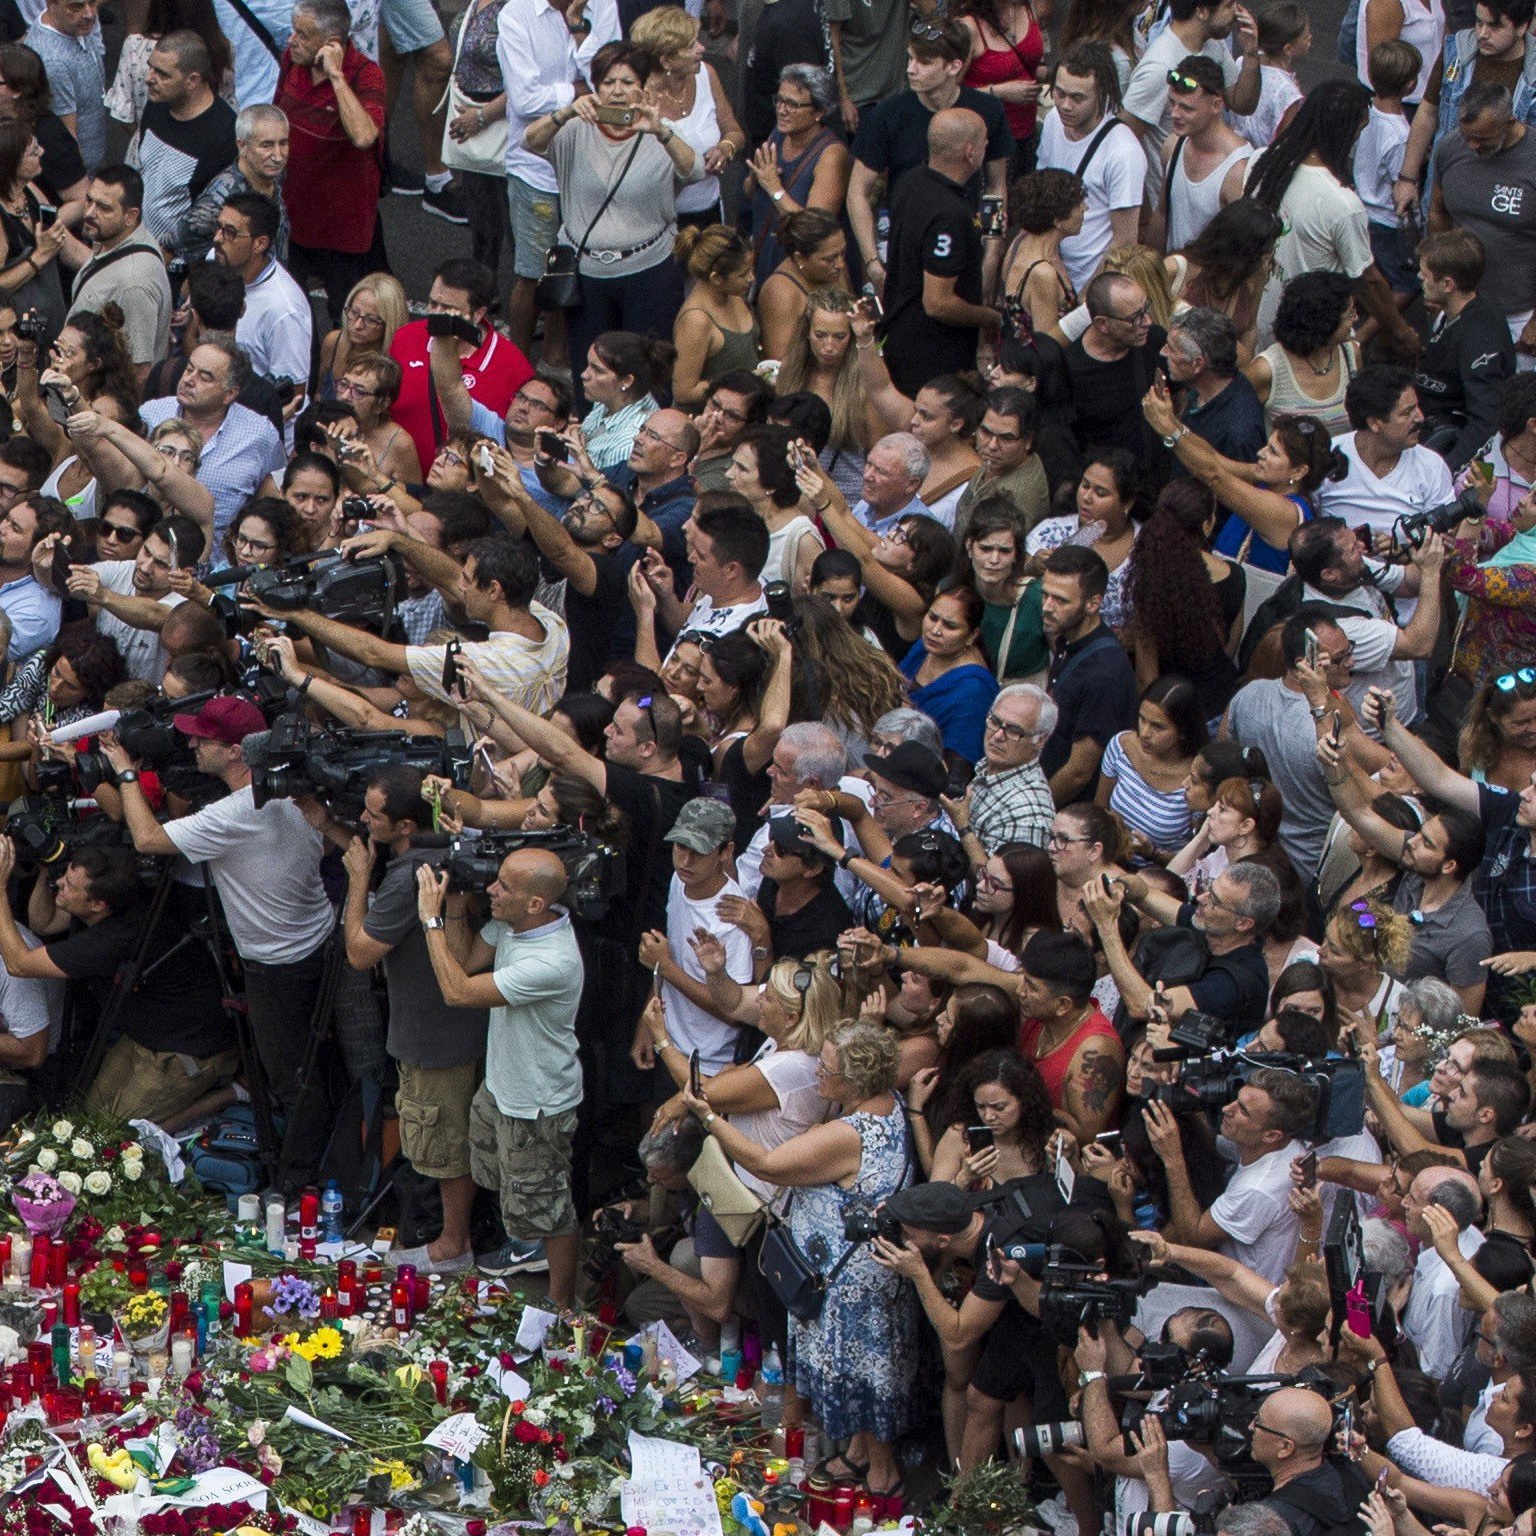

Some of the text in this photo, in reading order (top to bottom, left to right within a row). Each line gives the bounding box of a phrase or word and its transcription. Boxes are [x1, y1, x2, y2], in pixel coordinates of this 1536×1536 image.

[1494, 184, 1523, 198] SANTS
[1492, 195, 1521, 215] GE
[933, 234, 950, 256] 3
